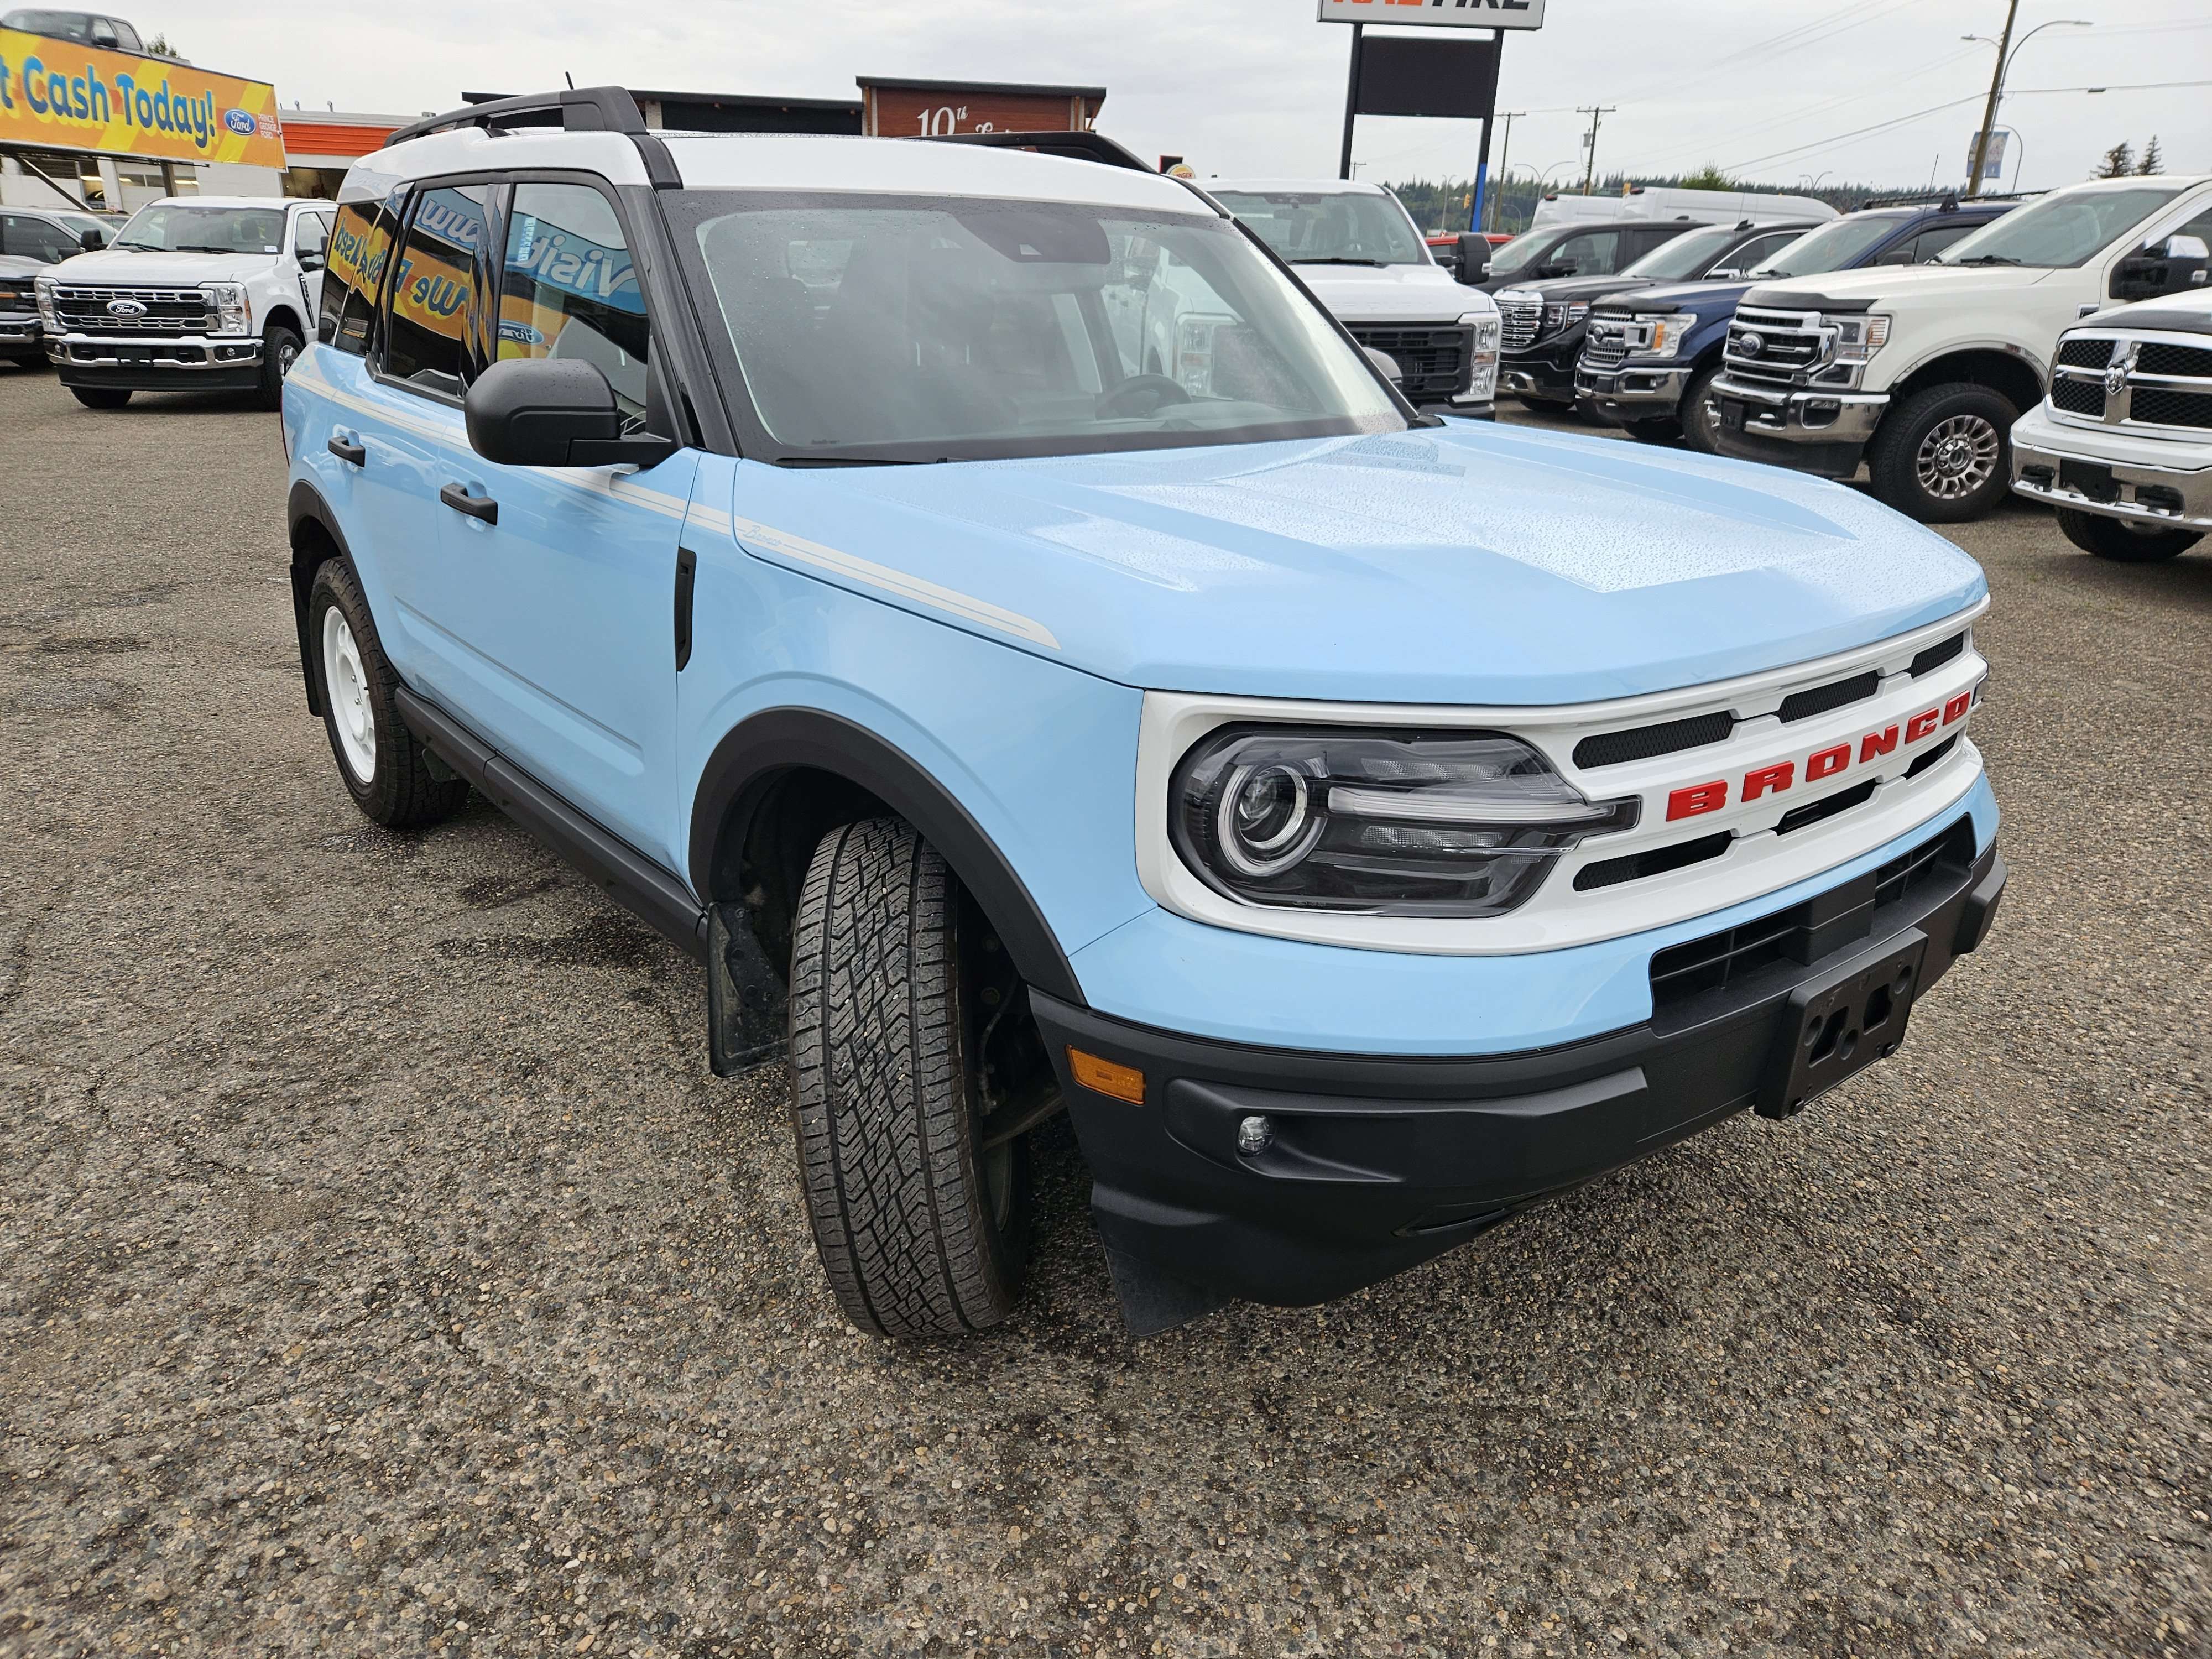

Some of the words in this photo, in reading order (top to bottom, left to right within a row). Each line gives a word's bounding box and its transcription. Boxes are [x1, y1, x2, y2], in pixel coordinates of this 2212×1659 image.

[24, 56, 110, 122] Cash
[115, 73, 215, 148] Today!
[229, 111, 252, 133] Ford
[114, 304, 135, 314] Ford
[1665, 690, 1970, 822] BRONCO
